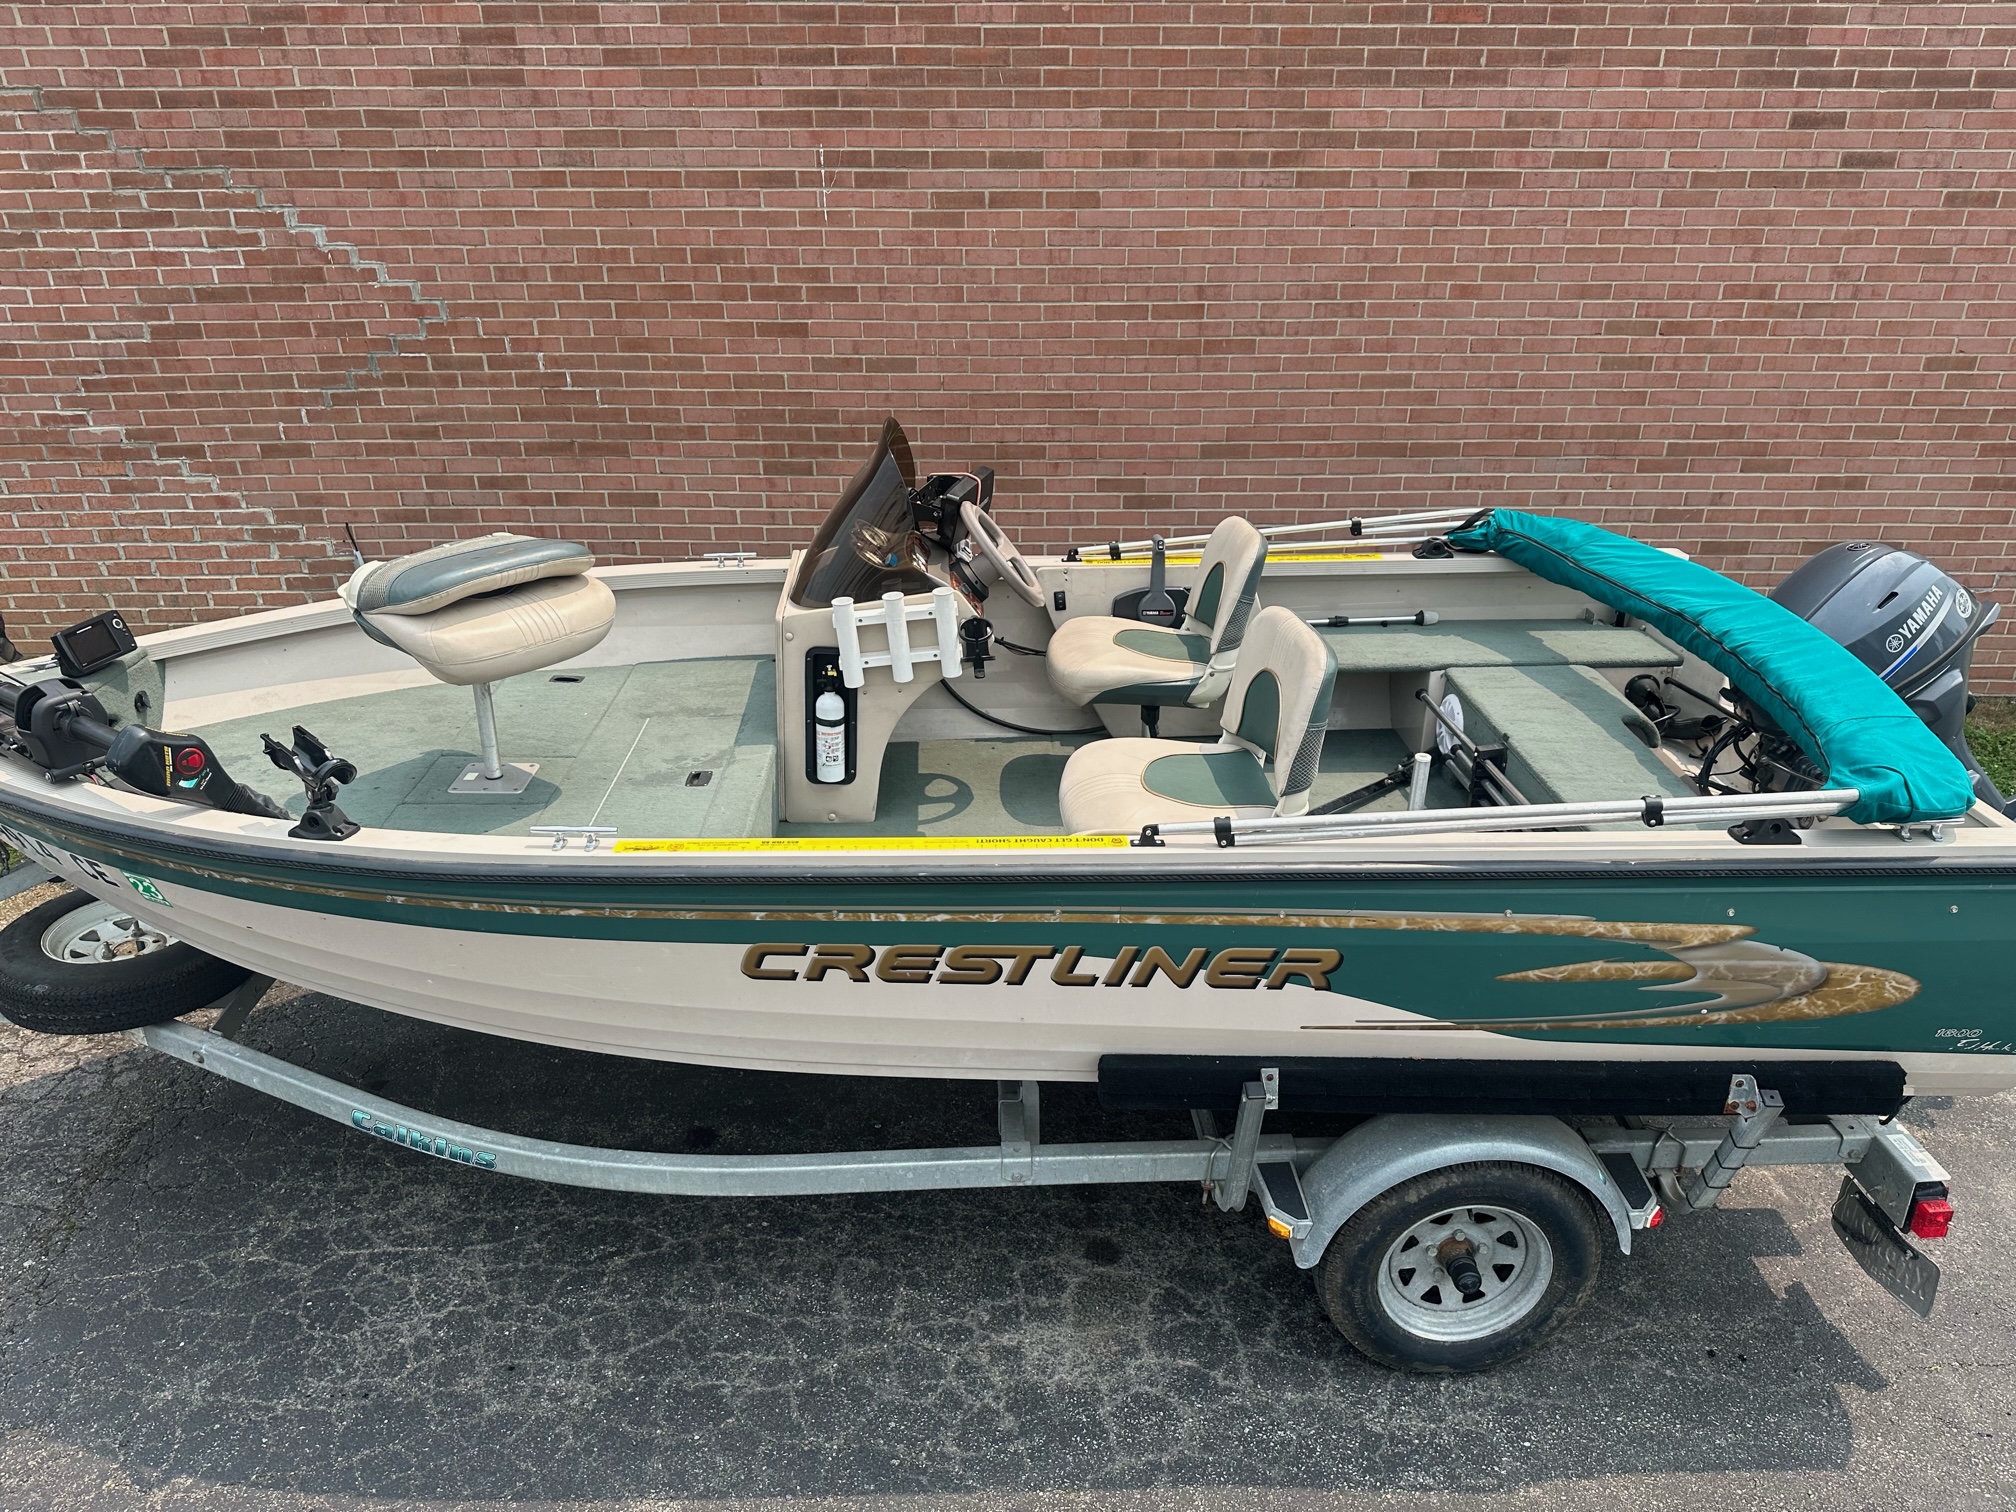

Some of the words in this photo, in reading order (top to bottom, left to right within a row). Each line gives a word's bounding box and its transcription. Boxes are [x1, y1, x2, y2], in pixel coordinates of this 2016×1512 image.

[1898, 585, 1943, 639] YAMAHA
[69, 853, 121, 888] CE
[128, 877, 164, 900] 23
[740, 942, 1344, 990] CRESTLINER
[351, 1109, 498, 1170] Calkins
